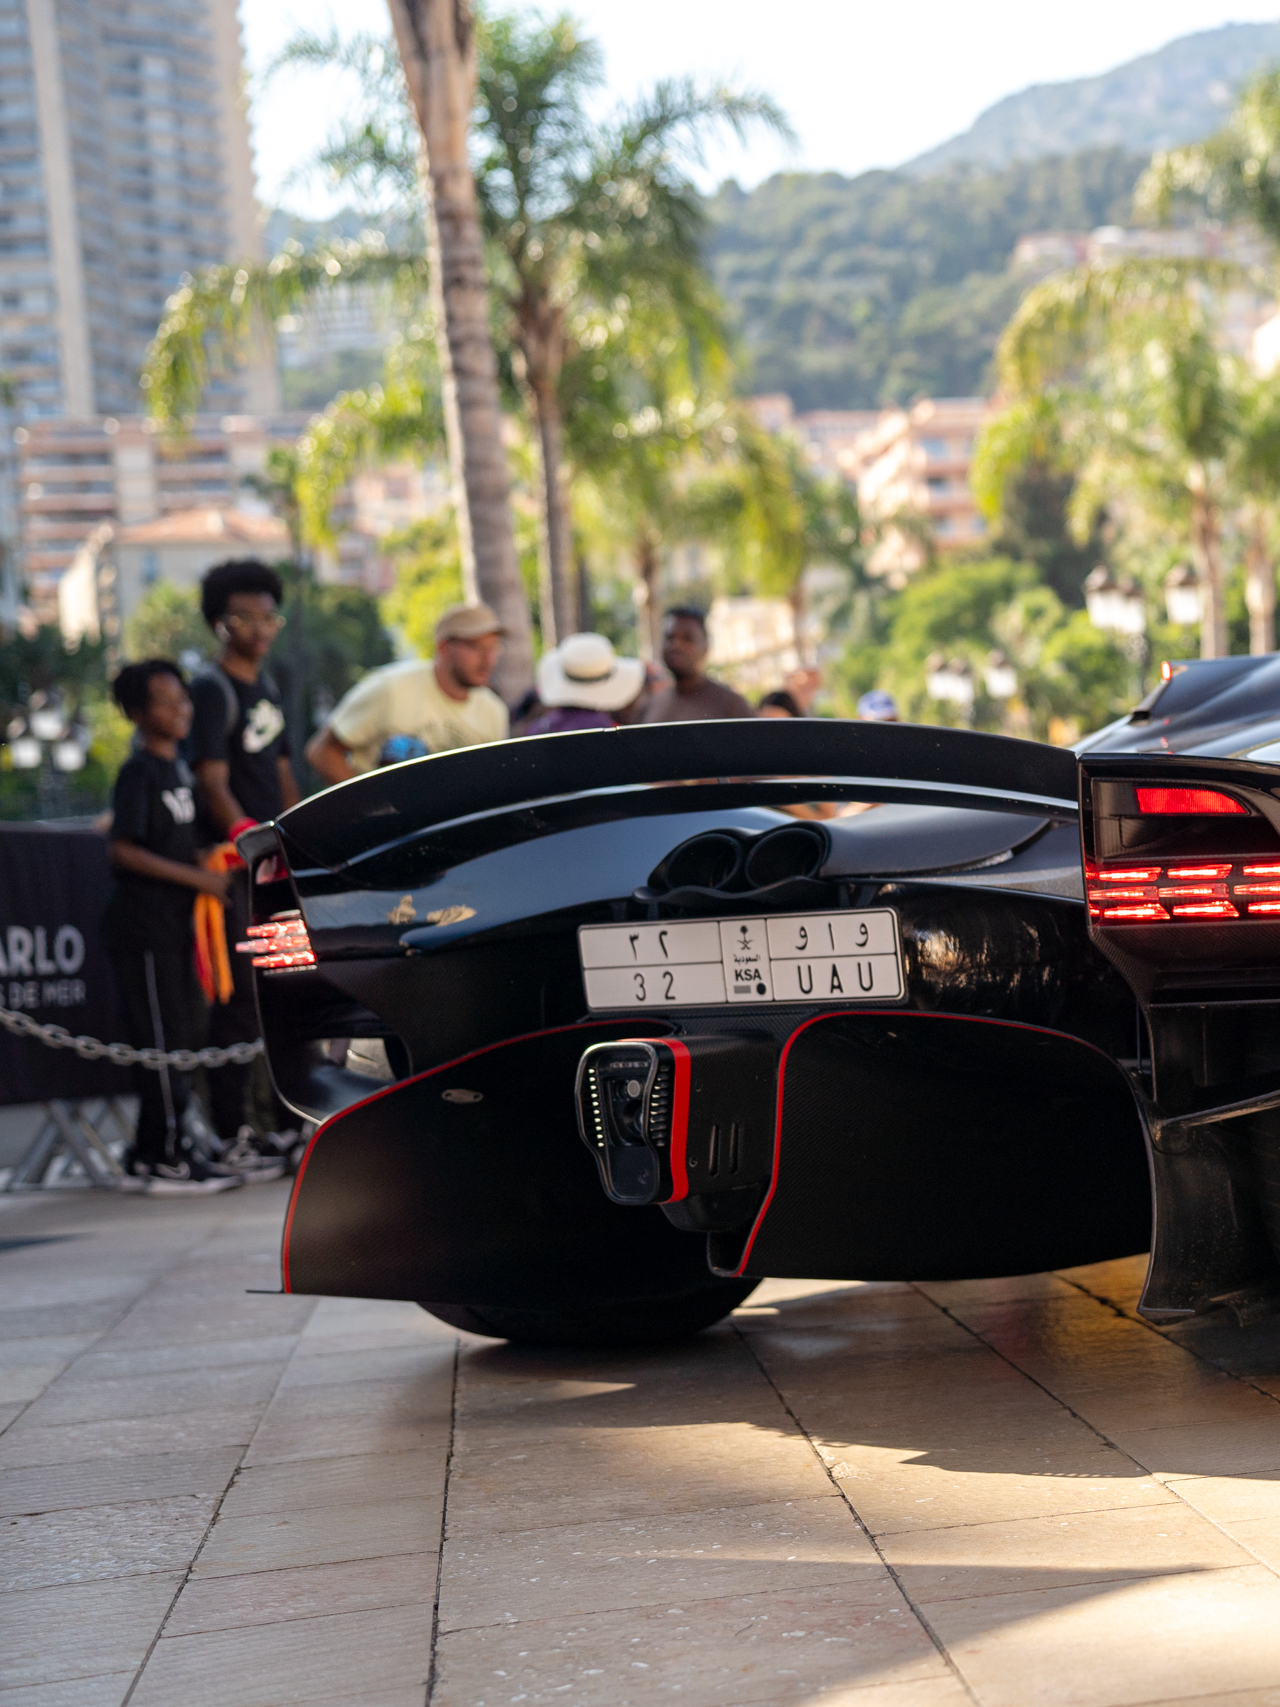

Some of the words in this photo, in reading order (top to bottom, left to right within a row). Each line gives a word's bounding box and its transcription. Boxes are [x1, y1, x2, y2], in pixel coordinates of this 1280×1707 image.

[634, 971, 676, 1001] 32
[734, 968, 762, 981] KSA
[9, 981, 39, 1009] DE
